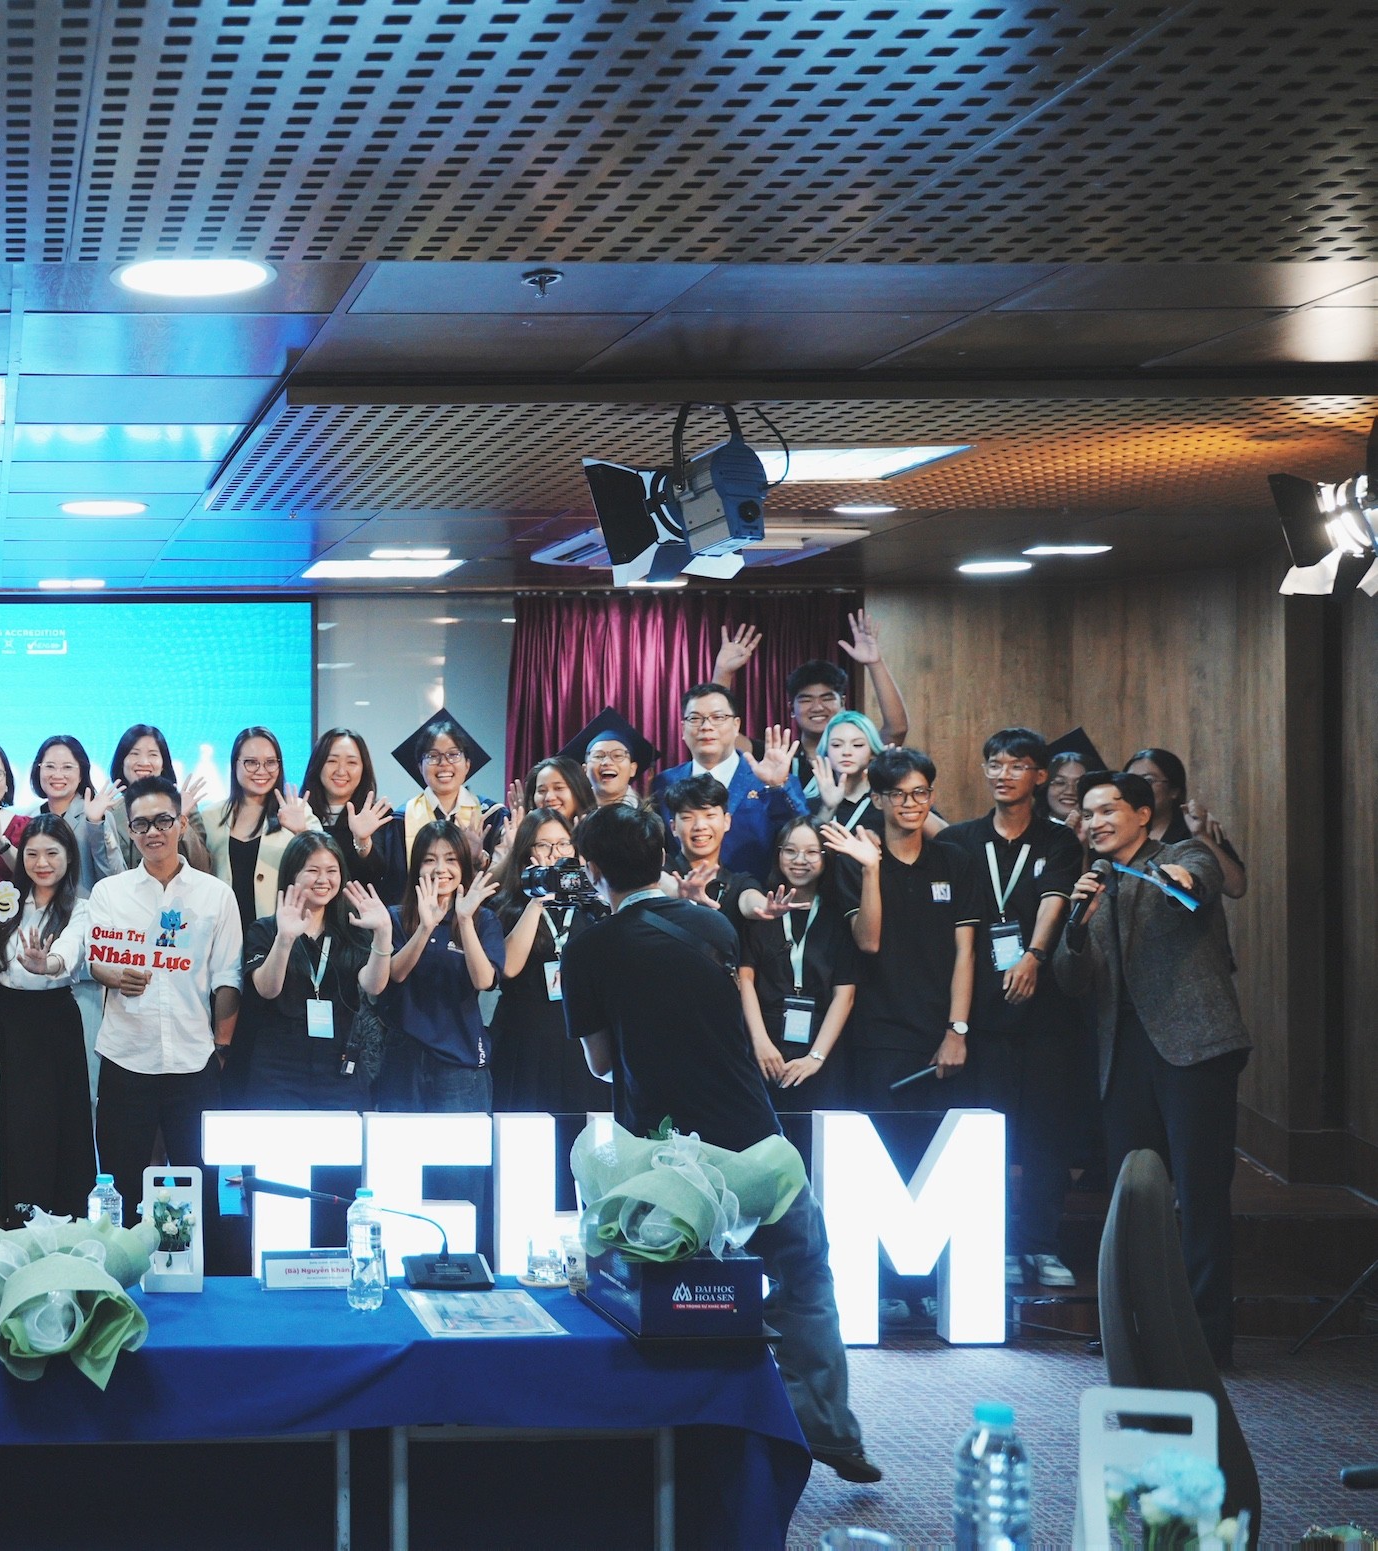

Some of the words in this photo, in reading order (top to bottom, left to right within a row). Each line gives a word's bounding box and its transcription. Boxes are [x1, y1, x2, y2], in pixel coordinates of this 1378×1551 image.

[127, 929, 146, 944] Trị
[88, 944, 146, 967] Nhân
[152, 951, 191, 973] Lực
